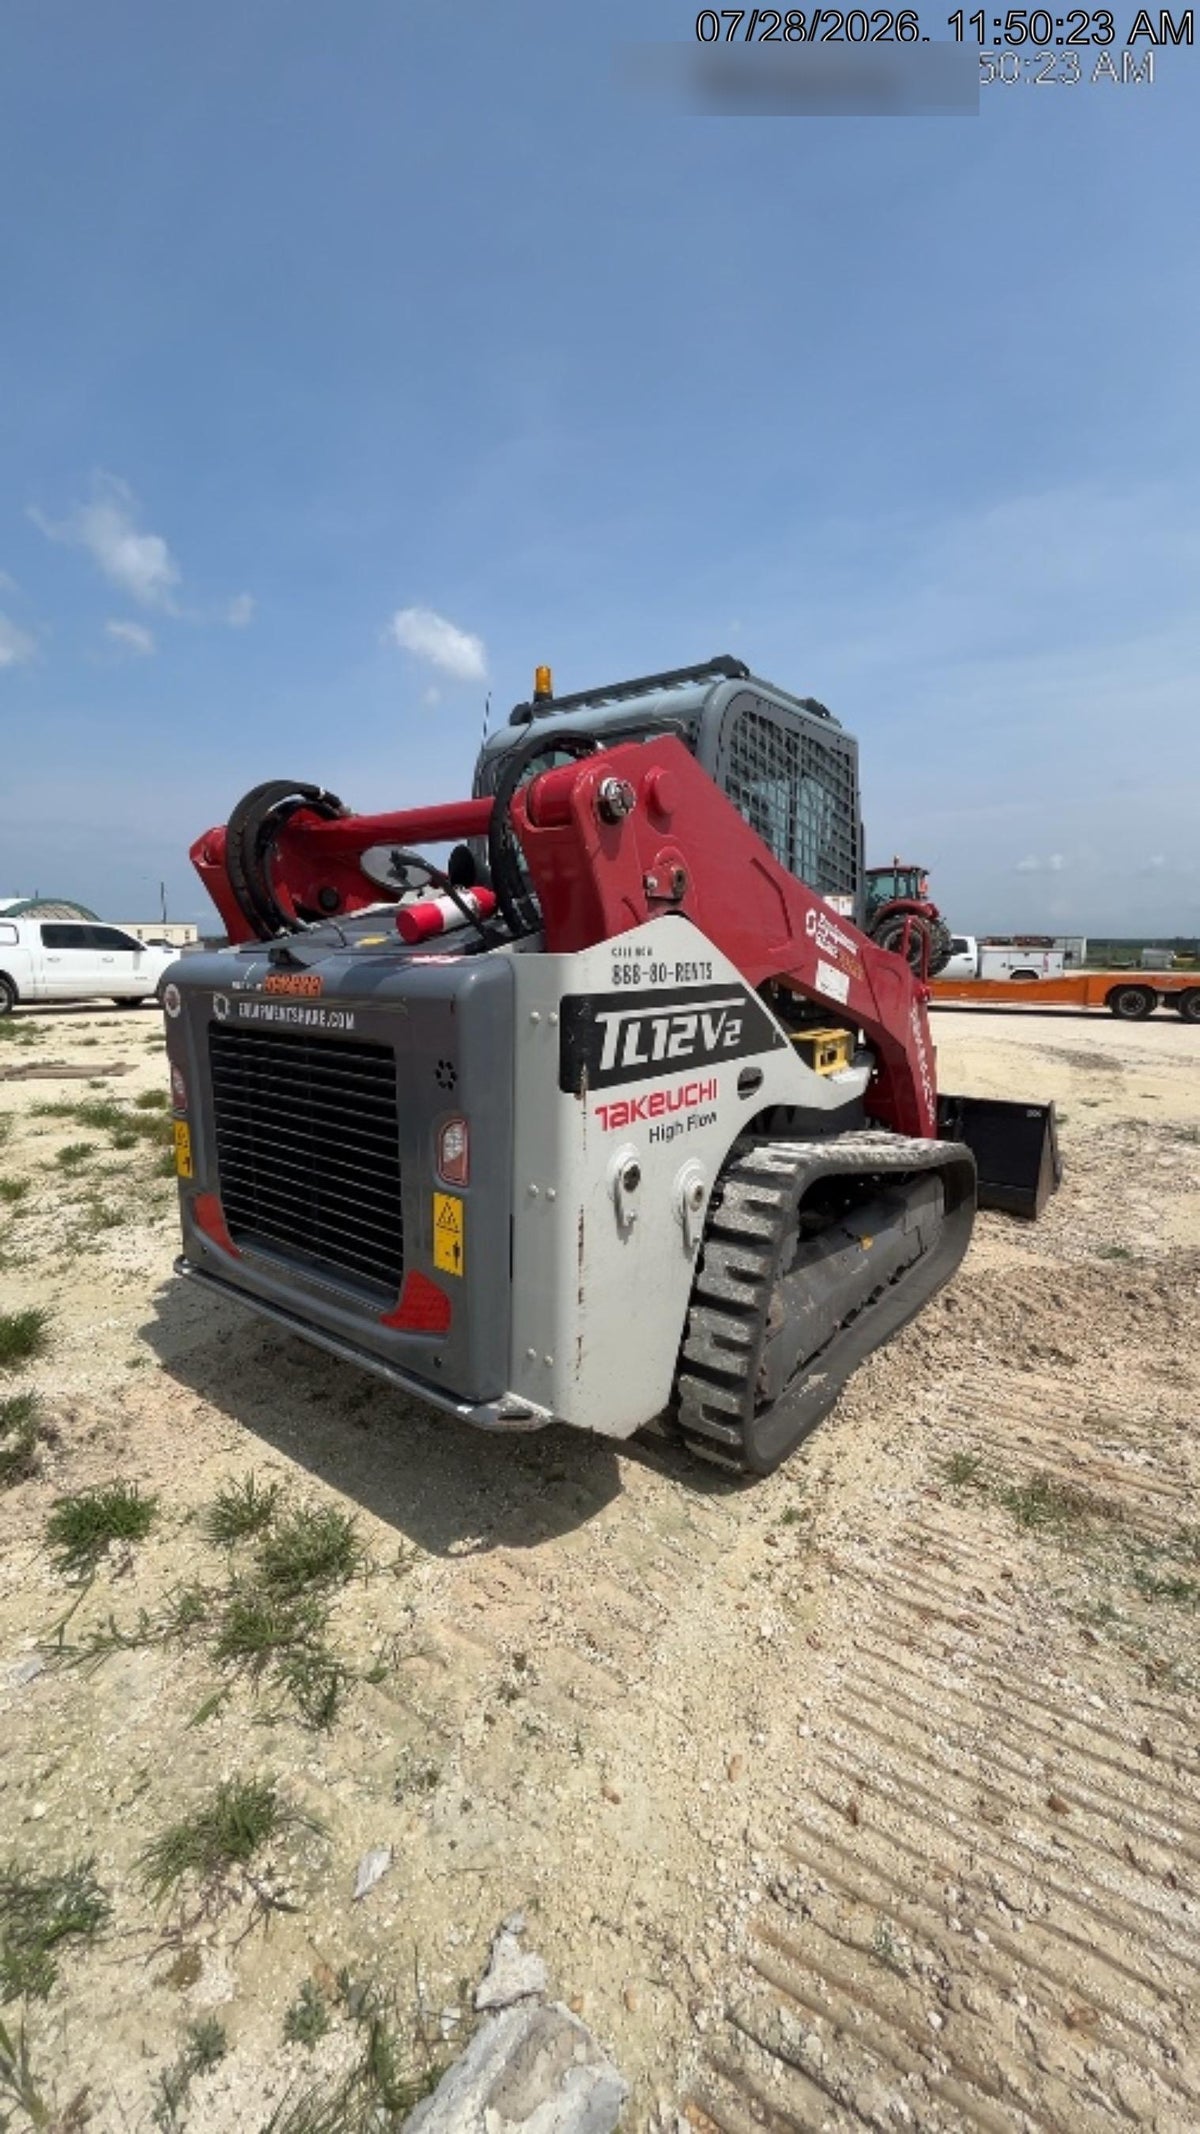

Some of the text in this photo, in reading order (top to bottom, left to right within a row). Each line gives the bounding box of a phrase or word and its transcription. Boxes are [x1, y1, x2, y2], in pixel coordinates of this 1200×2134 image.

[595, 1078, 718, 1132] TAKEUCHI
[649, 1111, 718, 1144] High Flow
